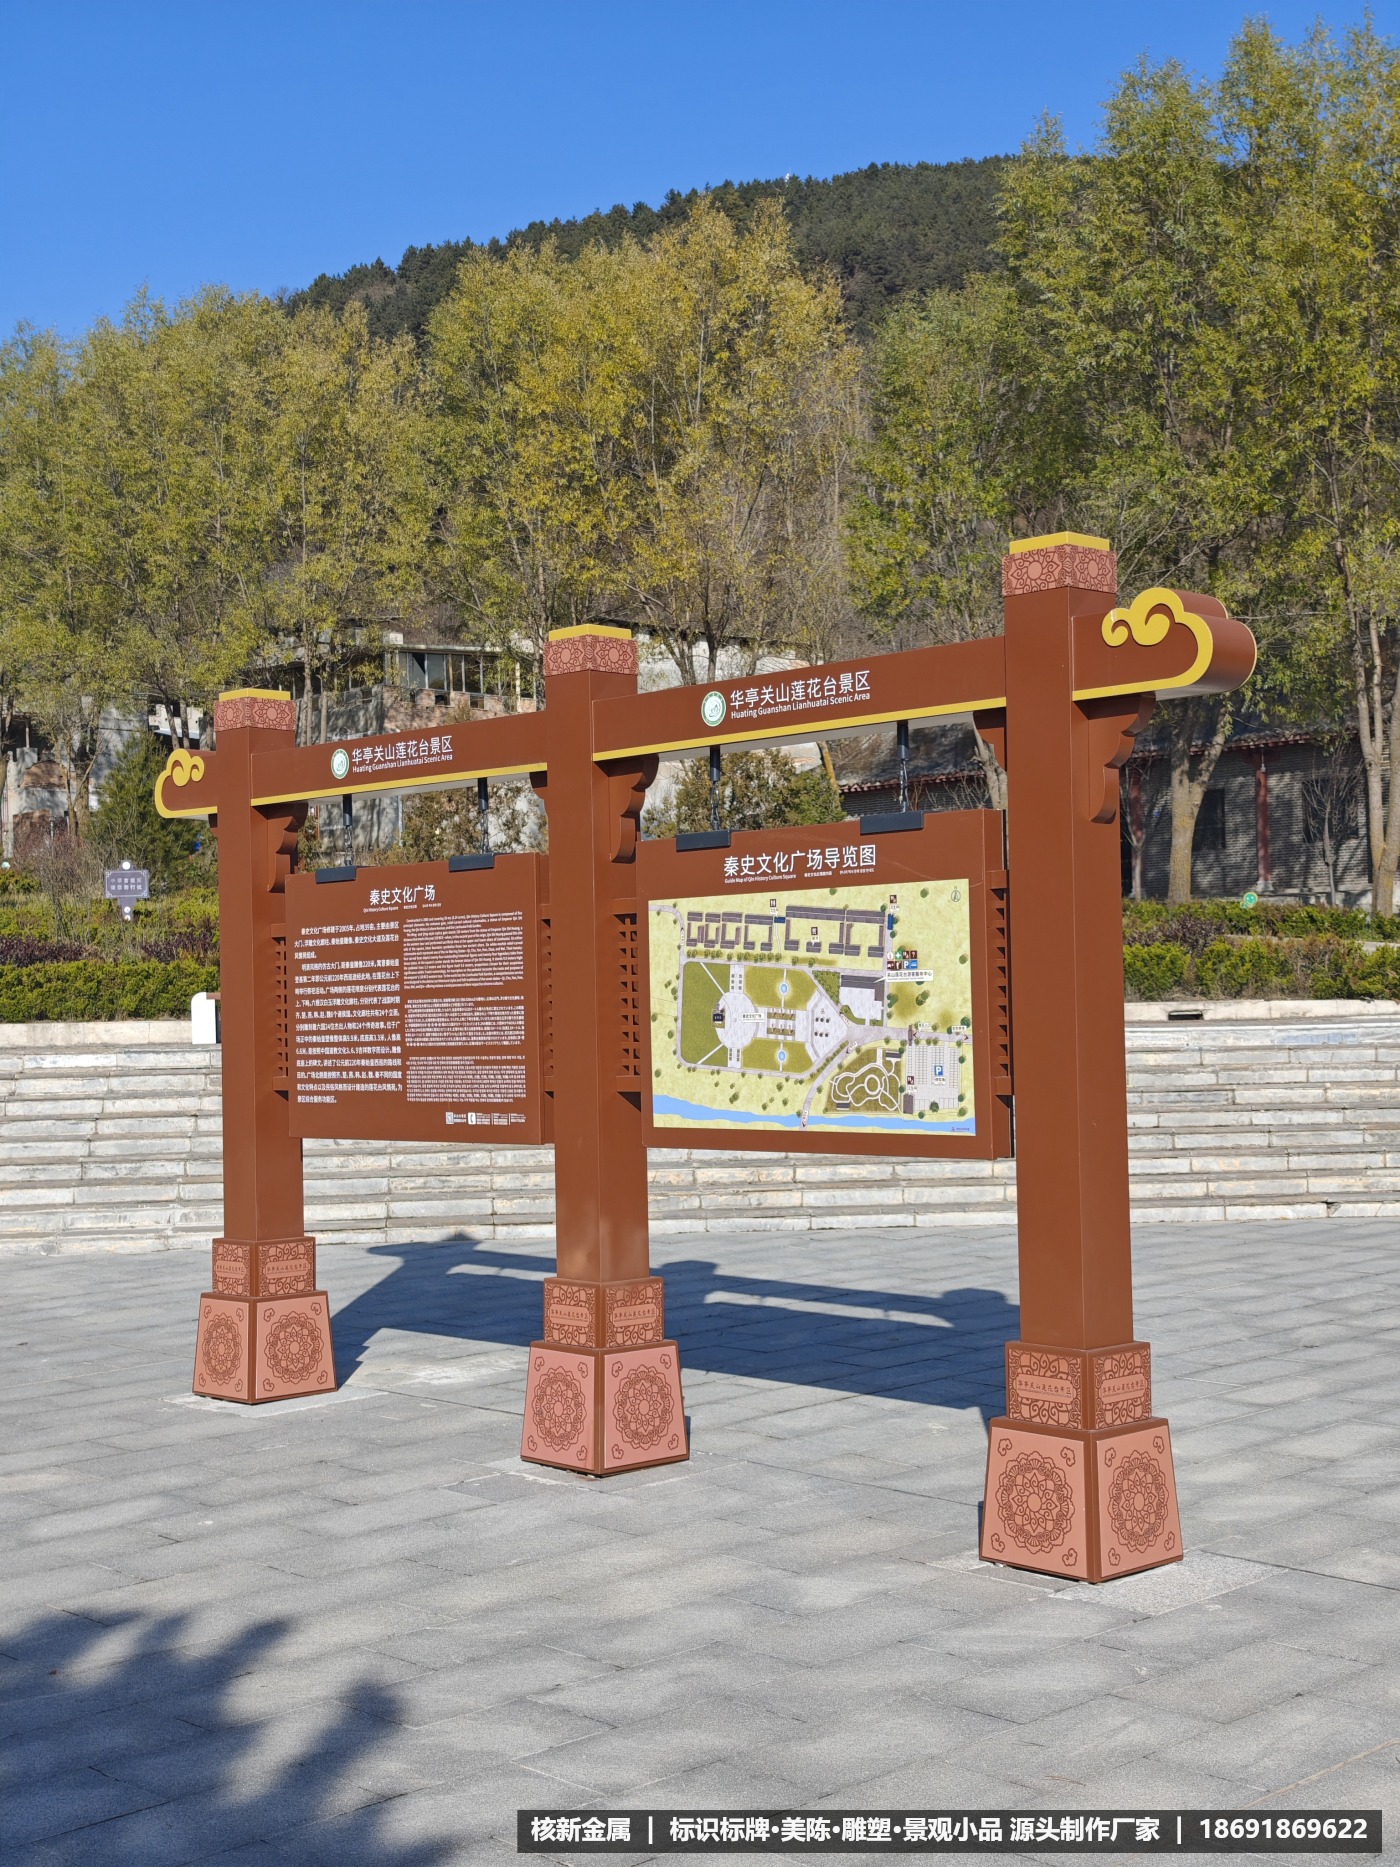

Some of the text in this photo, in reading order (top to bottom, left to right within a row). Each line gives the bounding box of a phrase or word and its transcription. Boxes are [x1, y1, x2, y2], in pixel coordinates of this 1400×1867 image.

[730, 670, 871, 710] 华亭关山莲花台景区
[731, 692, 870, 720] Huating Guanshan Lianhuatai Scenic Area
[352, 736, 453, 765] 华亭关山莲花台景区
[372, 762, 396, 770] Guanshan
[397, 758, 424, 768] Lianhuatai
[424, 756, 440, 764] Scenic
[724, 844, 876, 877] 秦史文化广场导览图
[370, 884, 436, 906] 秦史文化广场
